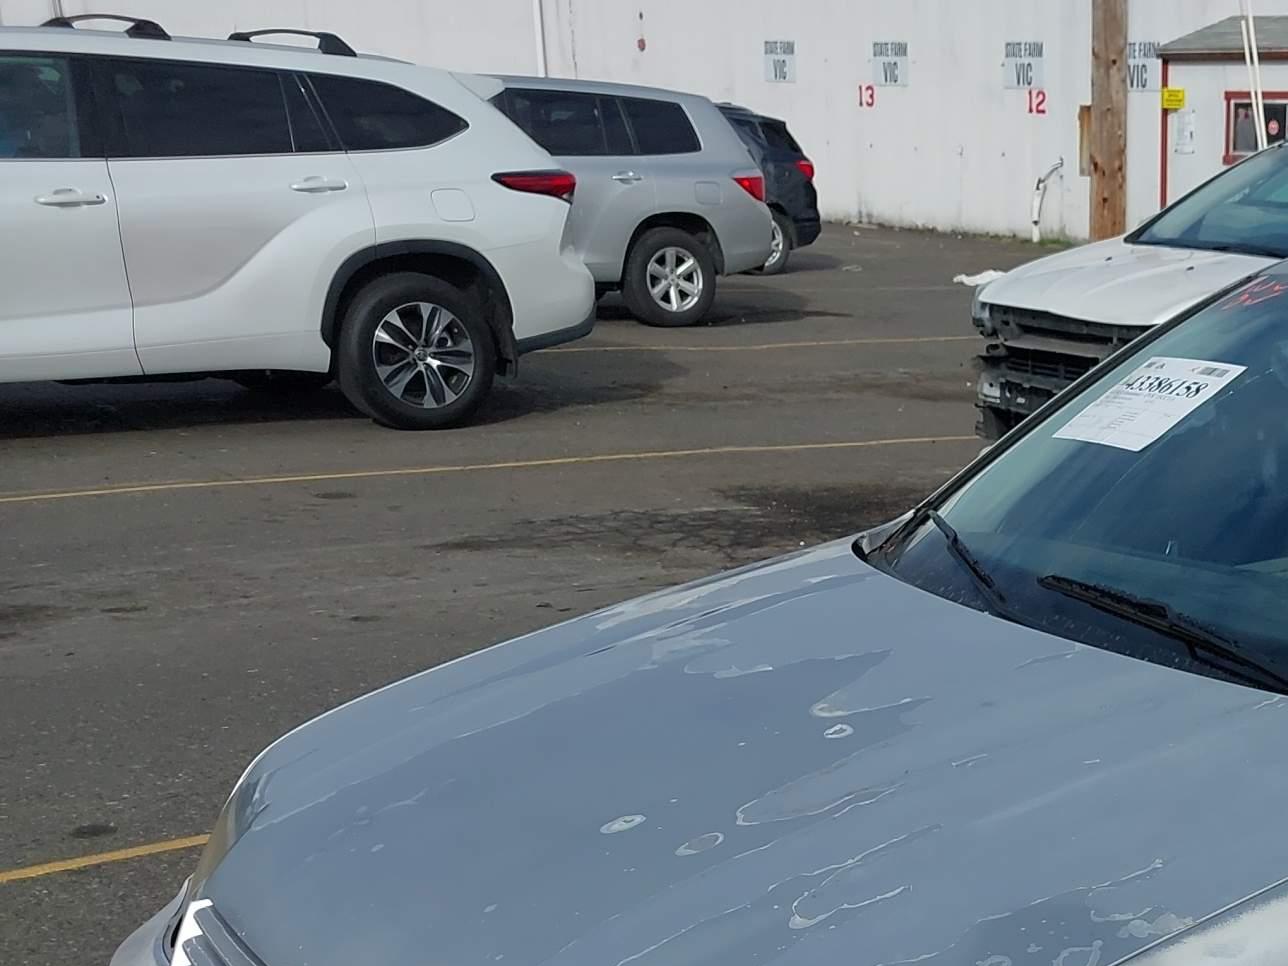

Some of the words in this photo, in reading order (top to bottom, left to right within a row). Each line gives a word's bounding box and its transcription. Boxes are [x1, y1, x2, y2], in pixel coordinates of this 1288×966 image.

[890, 43, 908, 57] FARM
[1005, 42, 1023, 58] STATE
[1024, 42, 1044, 58] FARM
[773, 59, 787, 80] VIC
[882, 62, 899, 84] VIC
[1015, 62, 1033, 86] VIC
[1128, 64, 1148, 88] VIC
[858, 85, 875, 107] 13
[1028, 90, 1047, 114] 12
[1126, 375, 1208, 399] 43386158
